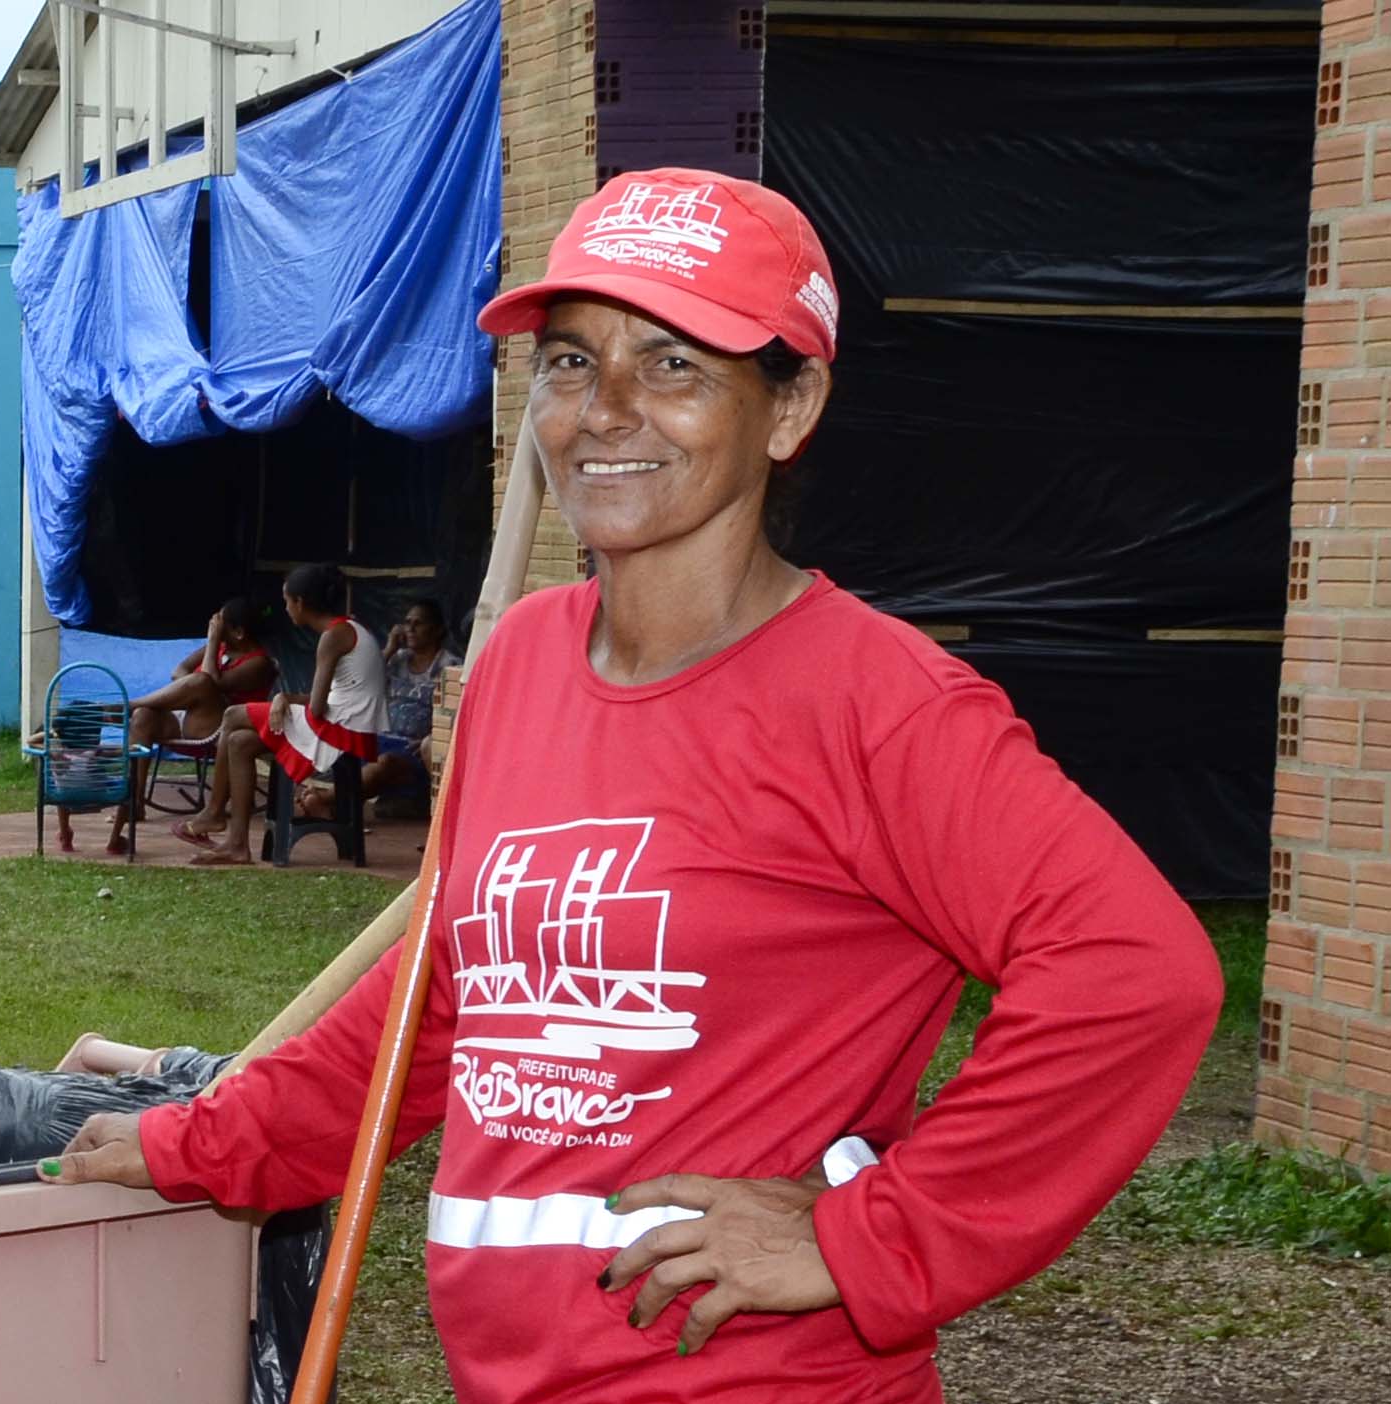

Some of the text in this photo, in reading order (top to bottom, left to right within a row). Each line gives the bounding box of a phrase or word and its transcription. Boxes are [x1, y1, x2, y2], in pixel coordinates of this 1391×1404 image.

[517, 1058, 617, 1089] PREFEITURA DE
[484, 1121, 508, 1140] COM
[510, 1126, 550, 1146] VOCÊ
[594, 1131, 608, 1147] A
